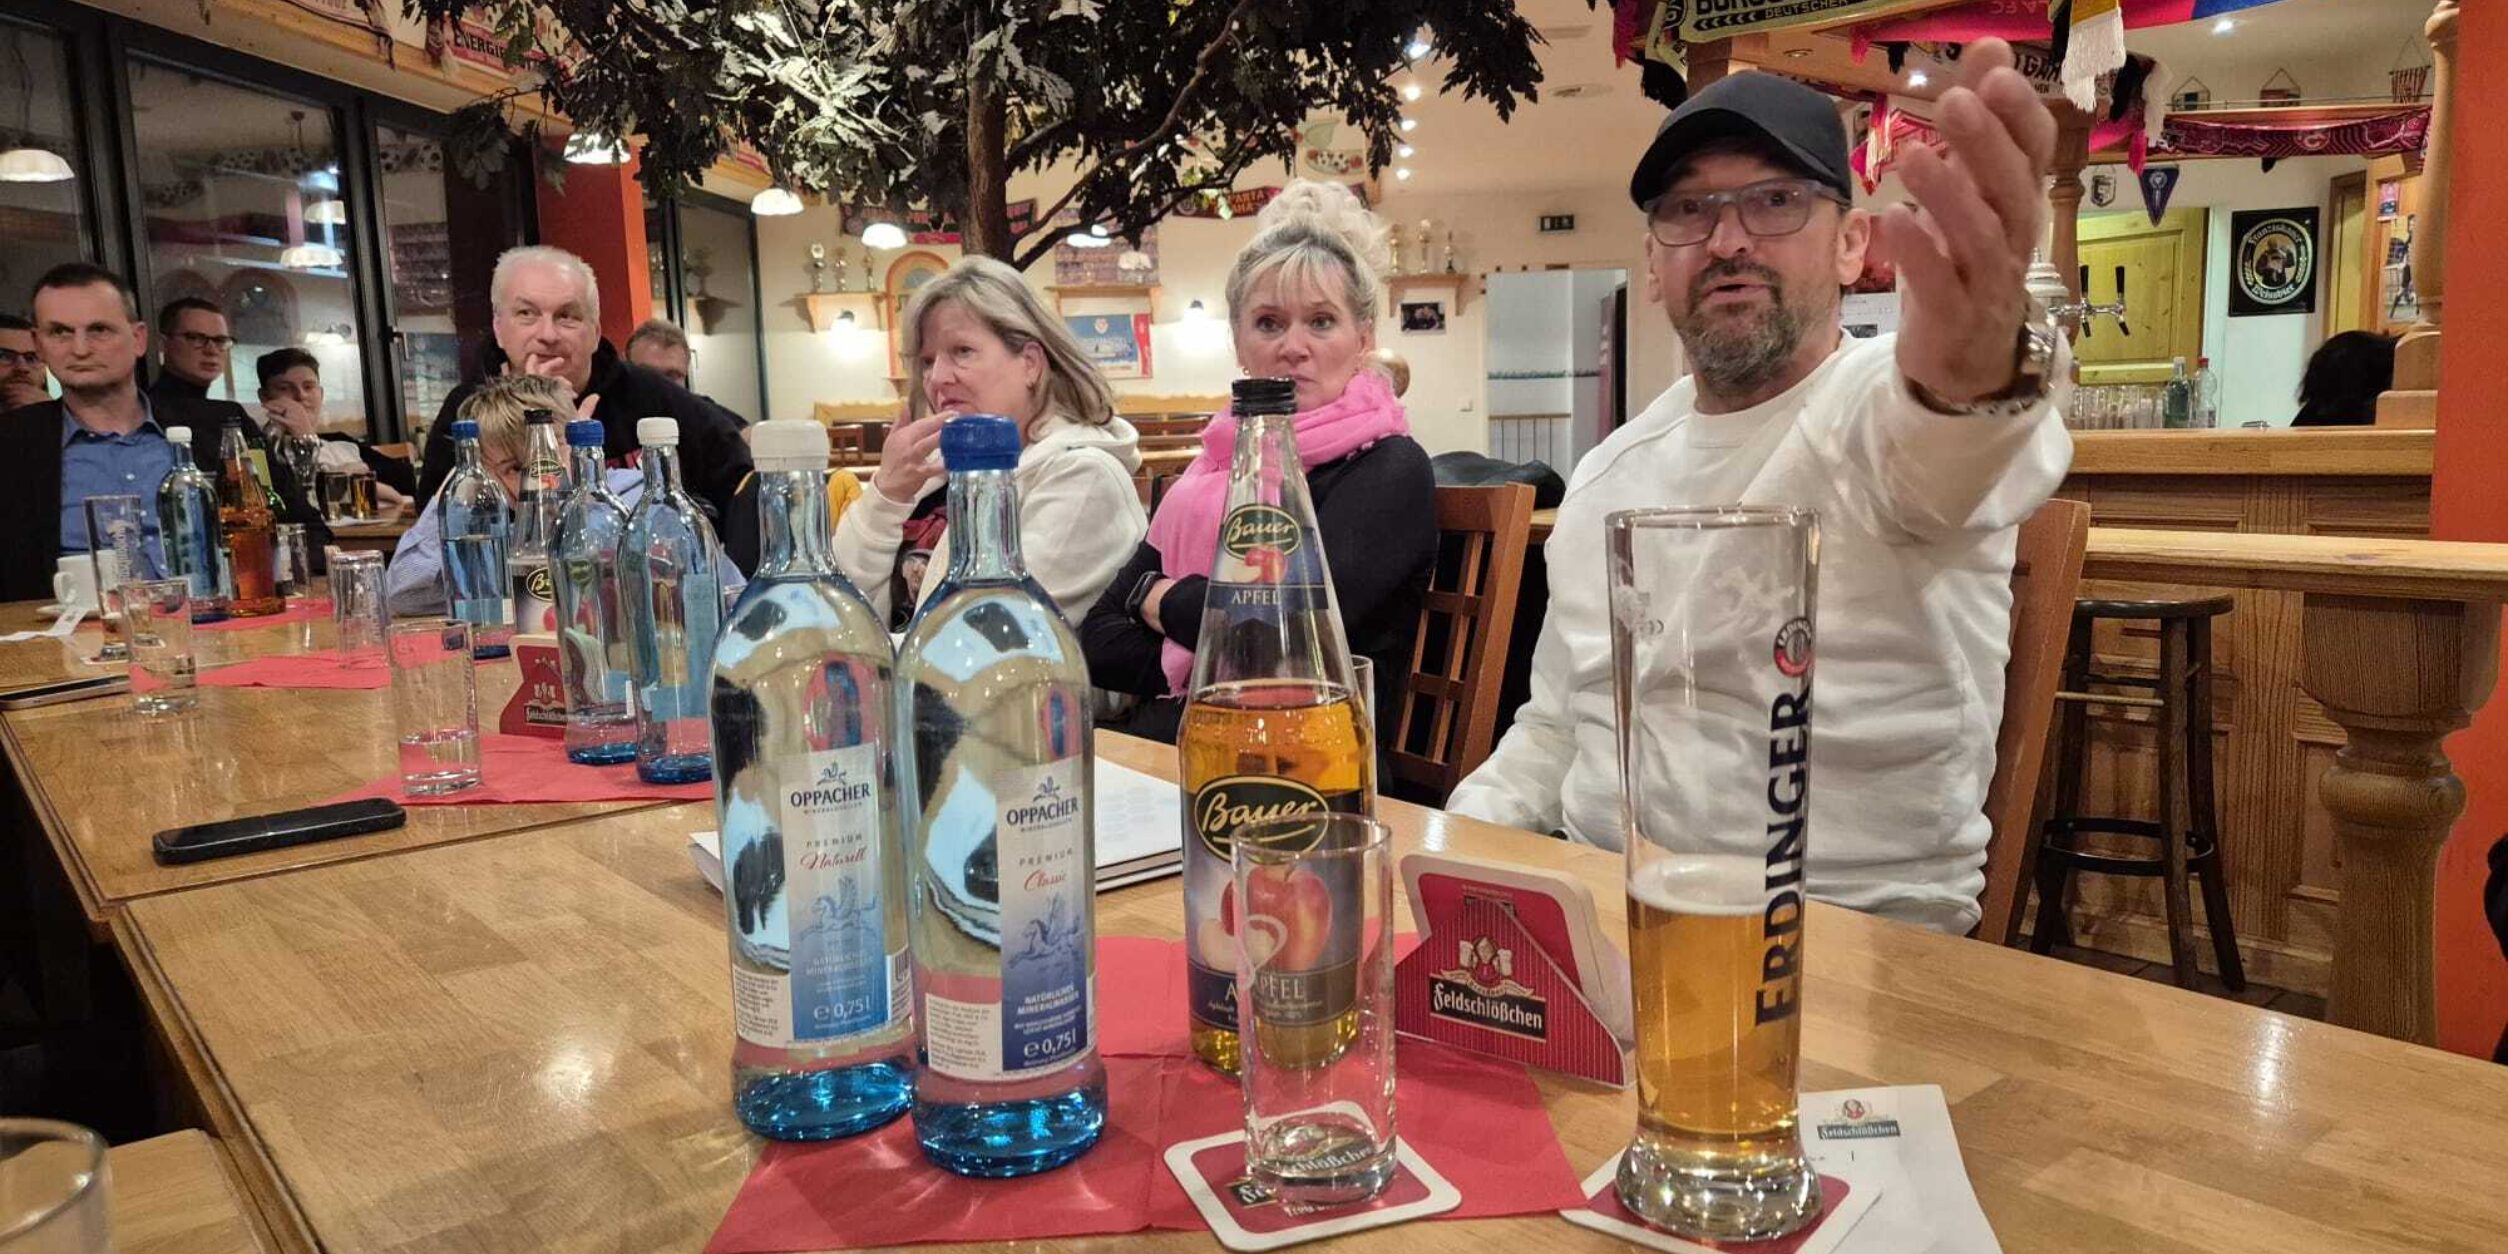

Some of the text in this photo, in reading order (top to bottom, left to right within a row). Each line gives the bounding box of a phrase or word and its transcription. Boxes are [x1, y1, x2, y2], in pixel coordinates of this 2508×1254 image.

[1226, 516, 1294, 542] Bauer
[1231, 589, 1282, 605] APFEL
[790, 783, 871, 808] OPPACHER
[1006, 797, 1078, 826] OPPACHER
[1202, 792, 1318, 832] Bauer
[1756, 684, 1810, 1026] ERDINGER
[1433, 981, 1543, 1030] Feldschlößchen
